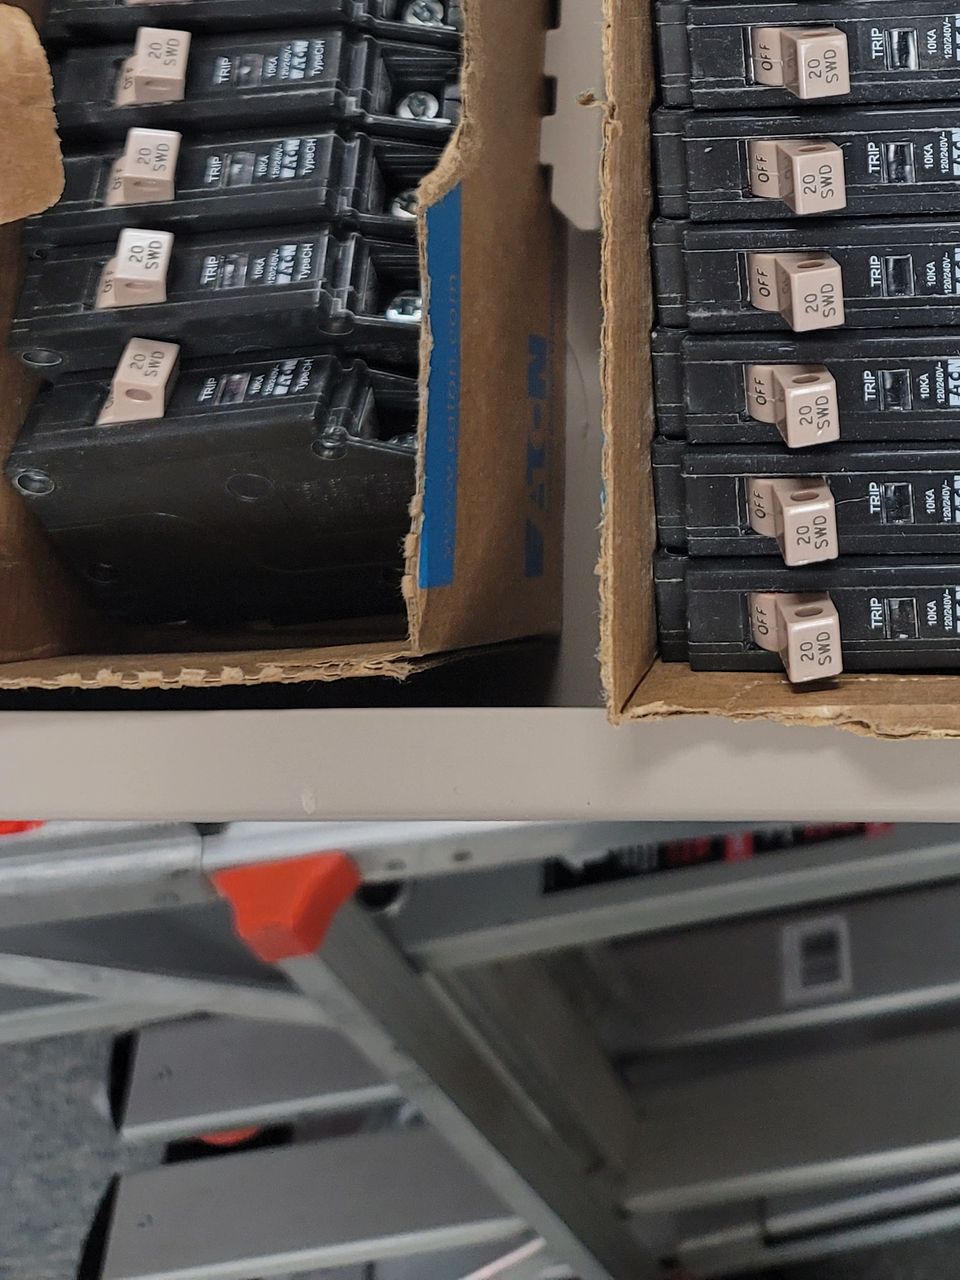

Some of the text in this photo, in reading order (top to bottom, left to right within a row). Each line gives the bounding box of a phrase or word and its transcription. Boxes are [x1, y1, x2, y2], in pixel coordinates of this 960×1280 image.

[149, 43, 163, 61] 20
[165, 38, 180, 65] SWD
[872, 28, 883, 60] TRIP
[927, 29, 936, 55] 10KA
[762, 44, 773, 71] OFF
[808, 58, 822, 80] 20
[825, 49, 838, 85] SWD
[137, 148, 151, 166] 20
[154, 143, 168, 171] SWD
[757, 155, 770, 183] OFF
[868, 143, 880, 174] TRIP
[924, 143, 934, 169] 10KA
[803, 173, 817, 195] 20
[820, 163, 835, 200] SWD
[129, 245, 144, 265] 20
[146, 240, 161, 268] SWD
[758, 267, 770, 297] OFF
[869, 256, 881, 287] TRIP
[927, 262, 936, 286] 10KA
[804, 293, 818, 314] 20
[822, 283, 837, 319] SWD
[130, 354, 146, 371] 20
[145, 349, 162, 377] SWD
[755, 379, 767, 405] OFF
[865, 371, 875, 402] TRIP
[920, 373, 930, 398] 10KA
[800, 405, 813, 427] 20
[816, 395, 830, 430] SWD
[754, 490, 766, 519] OFF
[868, 482, 880, 514] TRIP
[926, 489, 935, 514] 10KA
[796, 525, 810, 546] 20
[814, 515, 828, 551] SWD
[756, 607, 769, 635] OFF
[872, 598, 883, 629] TRIP
[928, 601, 937, 626] 10KA
[800, 640, 814, 662] 20
[817, 631, 831, 665] SWD
